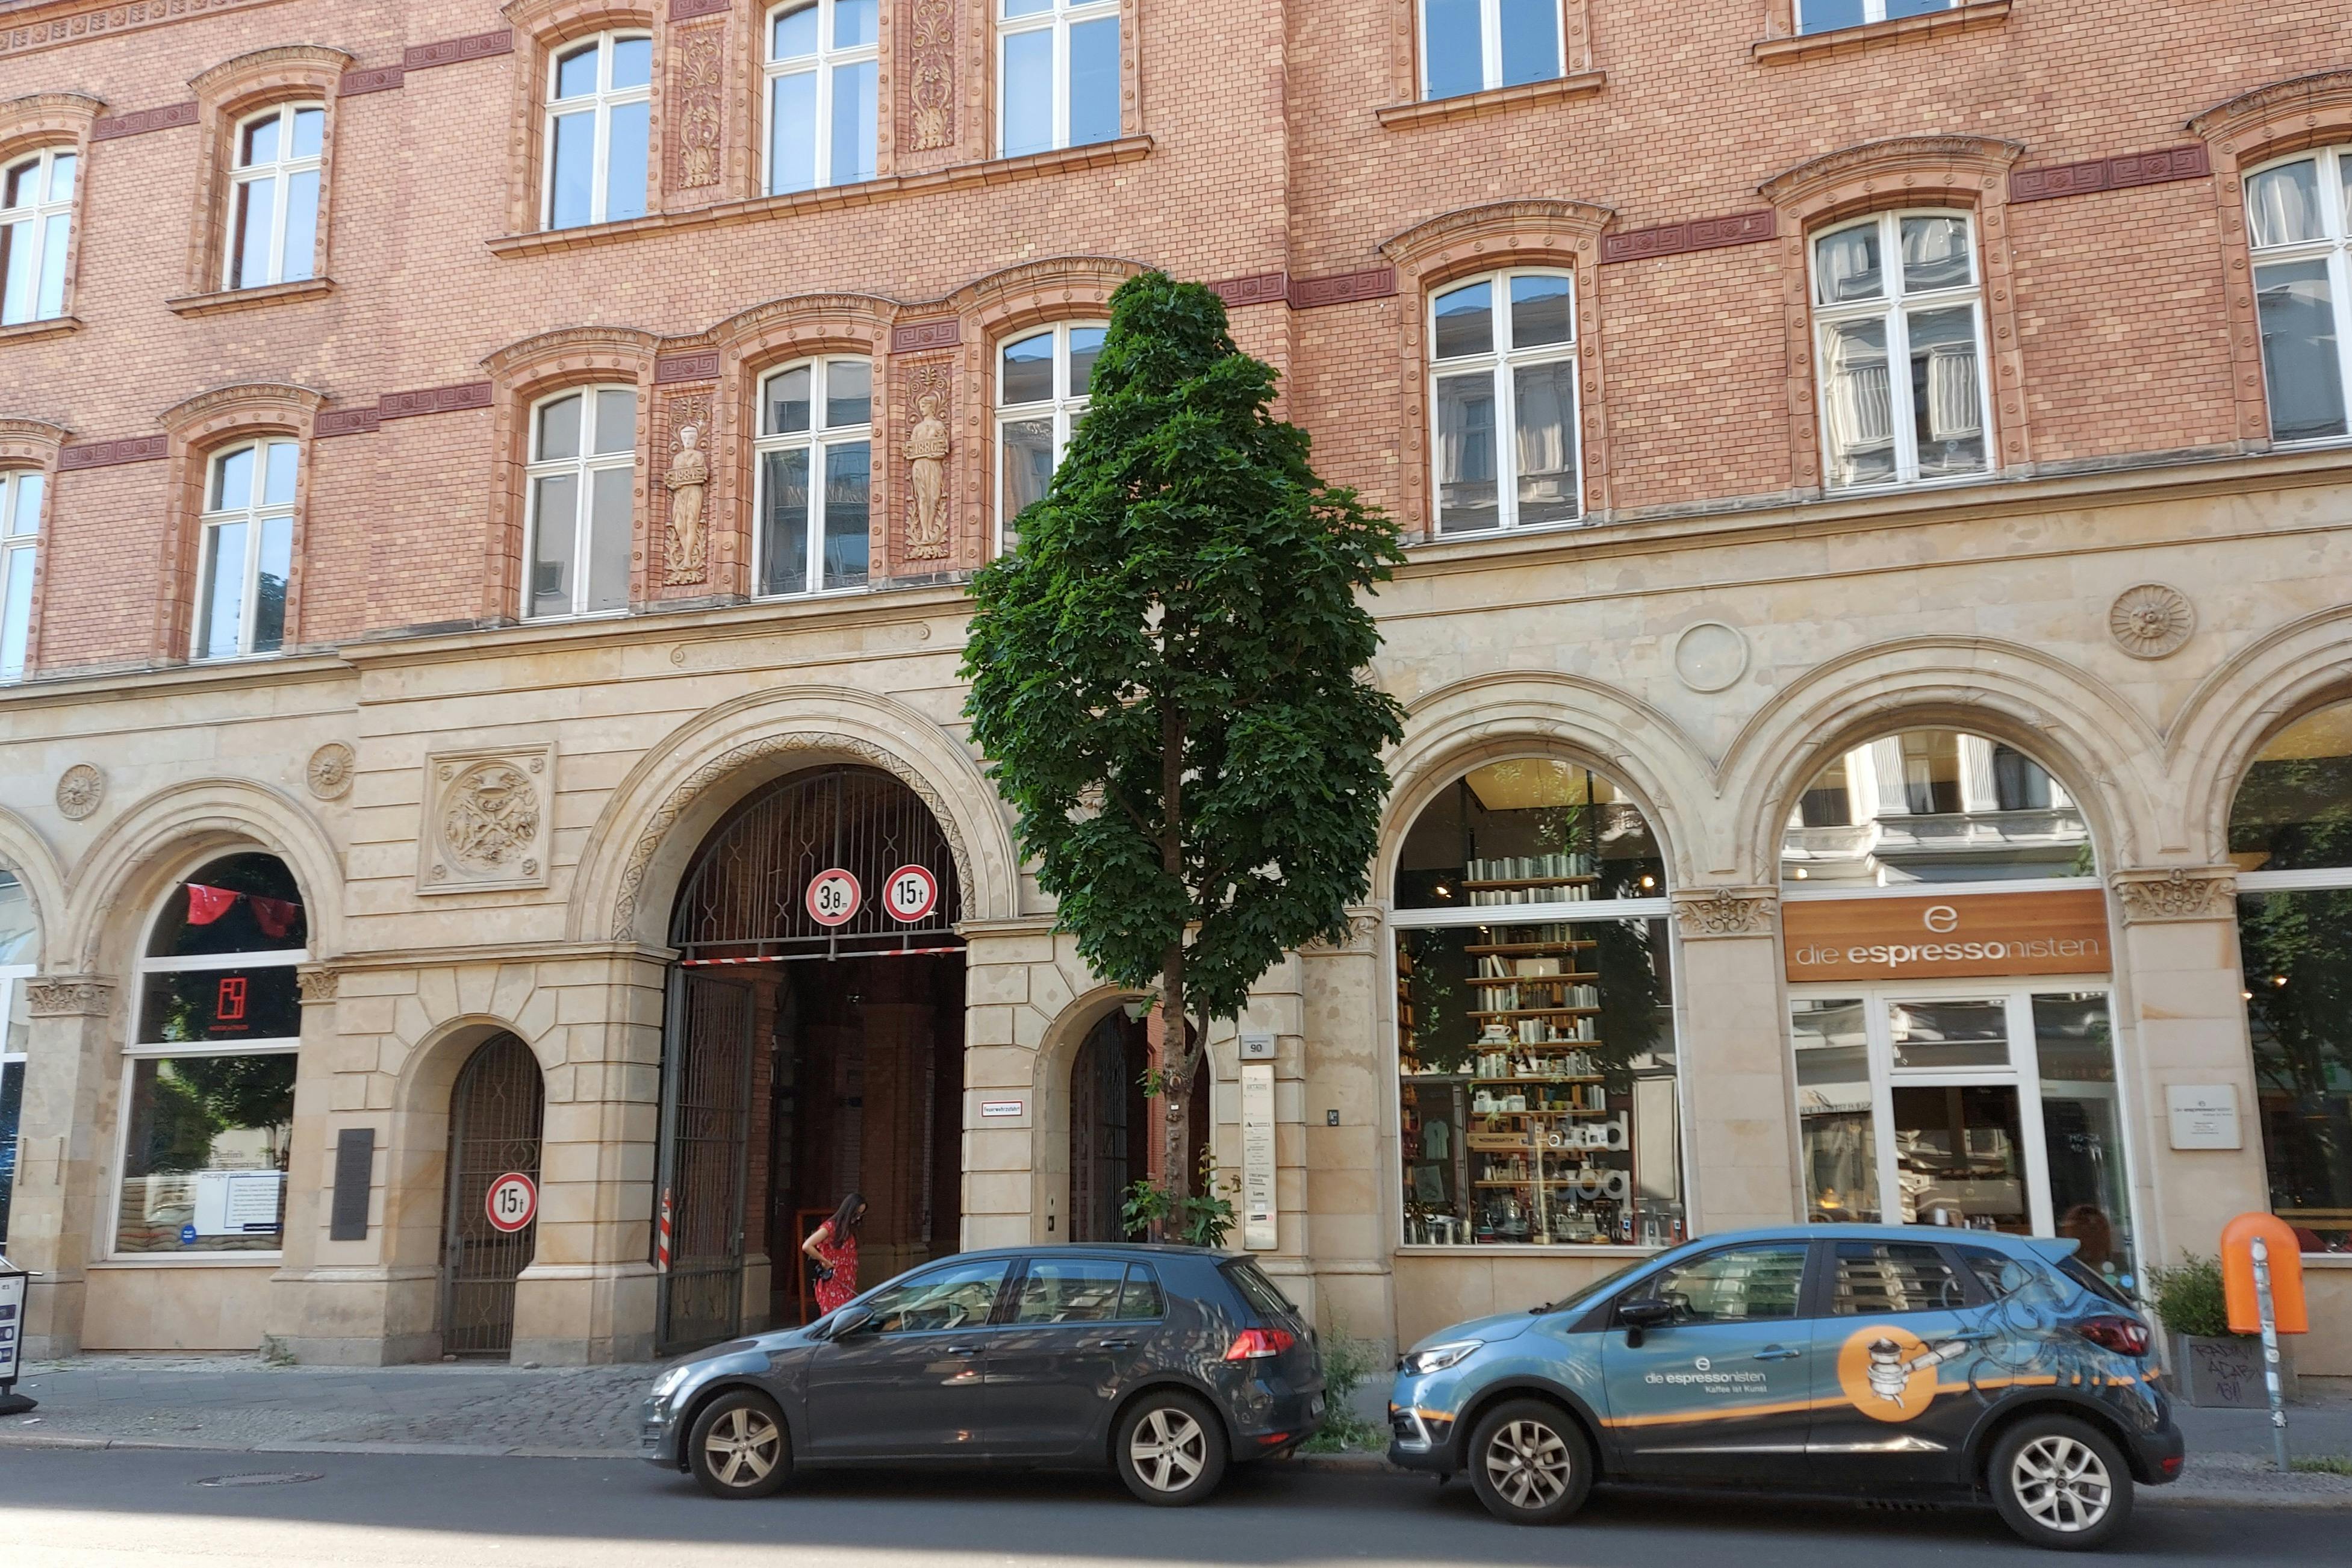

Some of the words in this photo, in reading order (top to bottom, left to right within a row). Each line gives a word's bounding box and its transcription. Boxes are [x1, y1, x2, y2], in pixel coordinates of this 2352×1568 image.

[916, 441, 937, 454] 1886
[897, 880, 916, 905] 15
[919, 889, 924, 903] t
[1796, 942, 1840, 965] die
[1847, 937, 2099, 968] espressonisten
[1250, 1044, 1262, 1053] 90
[500, 1189, 518, 1213] 15
[520, 1199, 524, 1213] t
[1646, 1373, 1664, 1384] die
[1666, 1371, 1766, 1386] espressonisten
